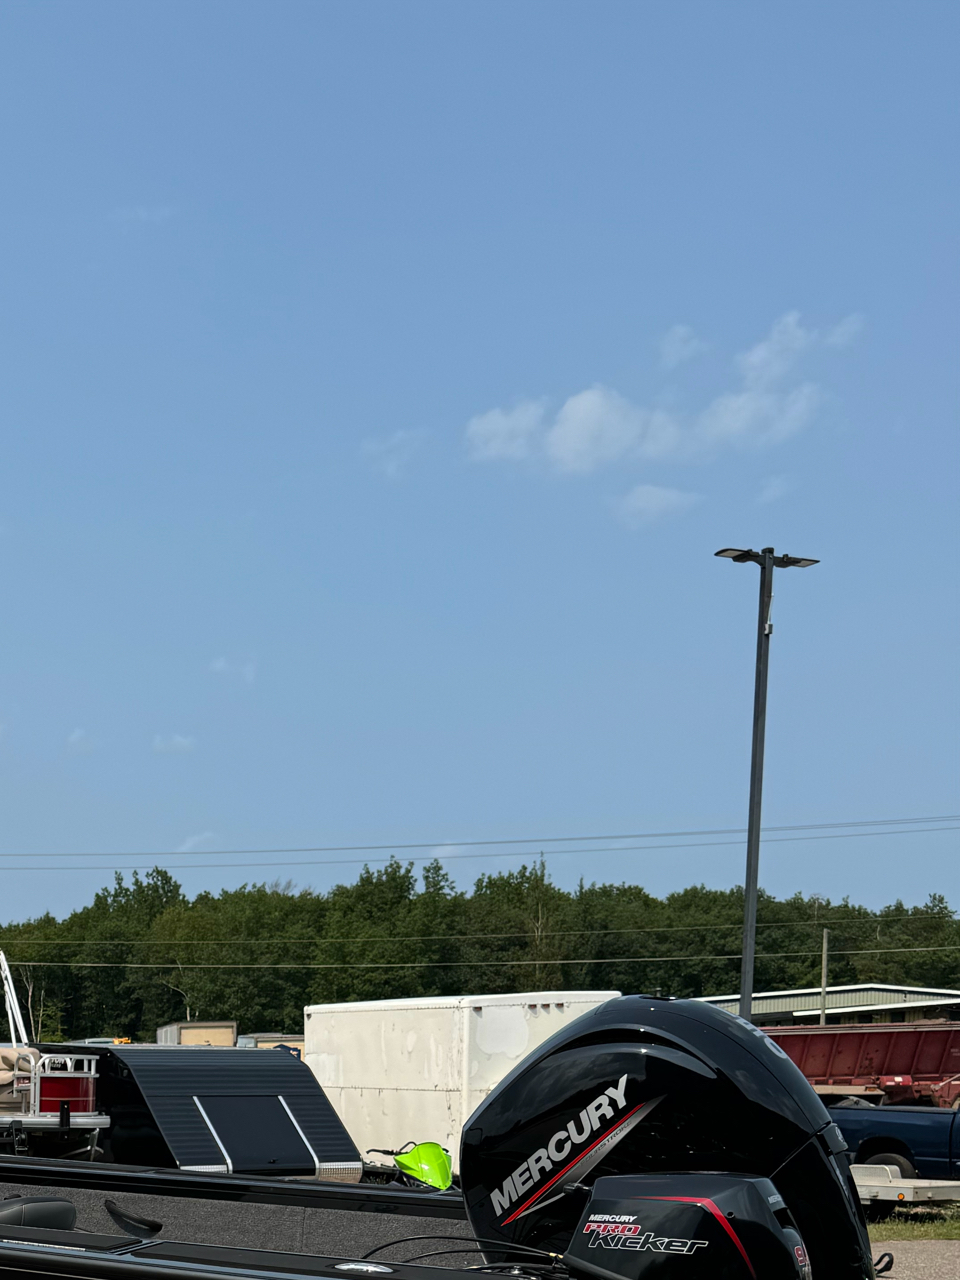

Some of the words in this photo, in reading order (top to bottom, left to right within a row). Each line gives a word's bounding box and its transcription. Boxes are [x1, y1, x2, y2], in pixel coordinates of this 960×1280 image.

[489, 1073, 628, 1217] MERCURY
[579, 1120, 632, 1166] FOURSTROKE
[583, 1222, 642, 1236] PRO
[588, 1214, 638, 1223] MERCURY
